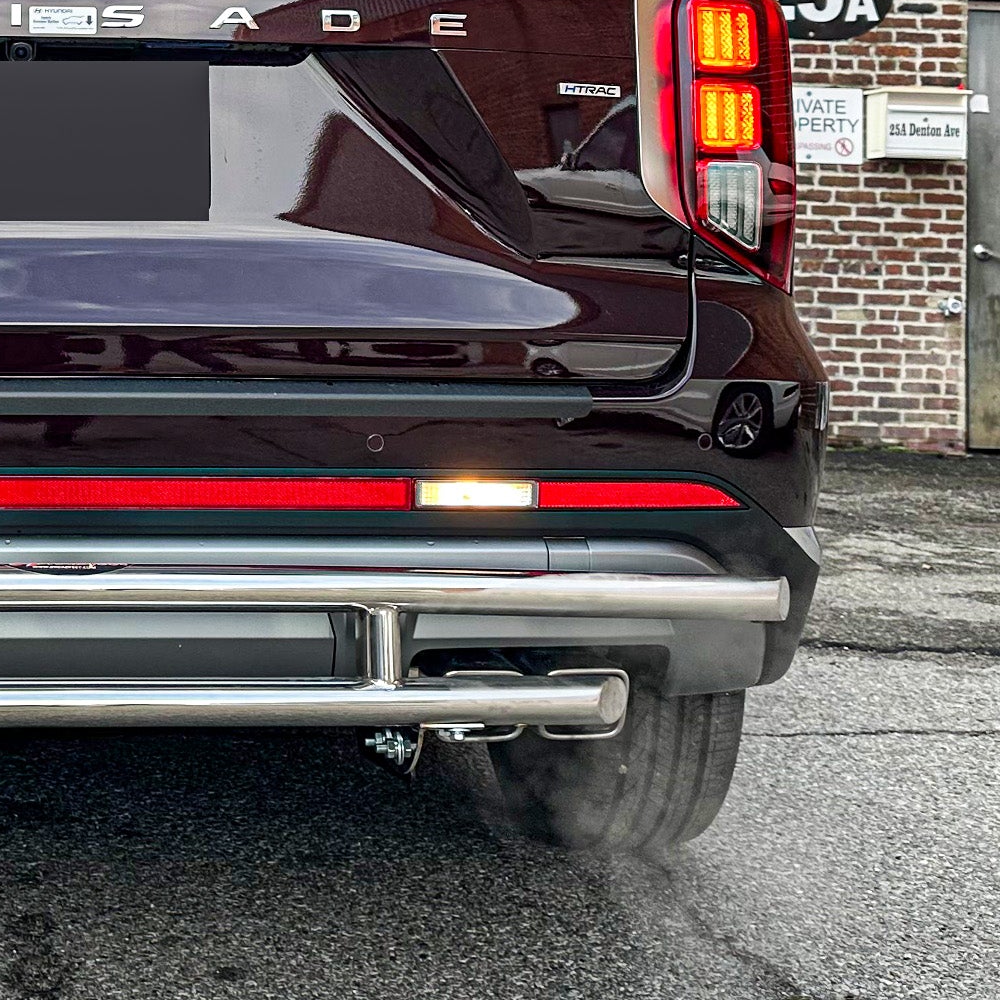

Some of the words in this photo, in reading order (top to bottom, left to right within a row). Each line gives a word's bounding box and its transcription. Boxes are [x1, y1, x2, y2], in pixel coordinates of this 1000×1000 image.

[564, 84, 617, 96] HTRAC
[796, 98, 847, 115] IVATE
[795, 116, 860, 133] PERTY
[889, 123, 907, 137] 25A
[909, 122, 942, 137] Denton
[943, 123, 960, 138] Ave
[798, 142, 832, 151] PASSING
